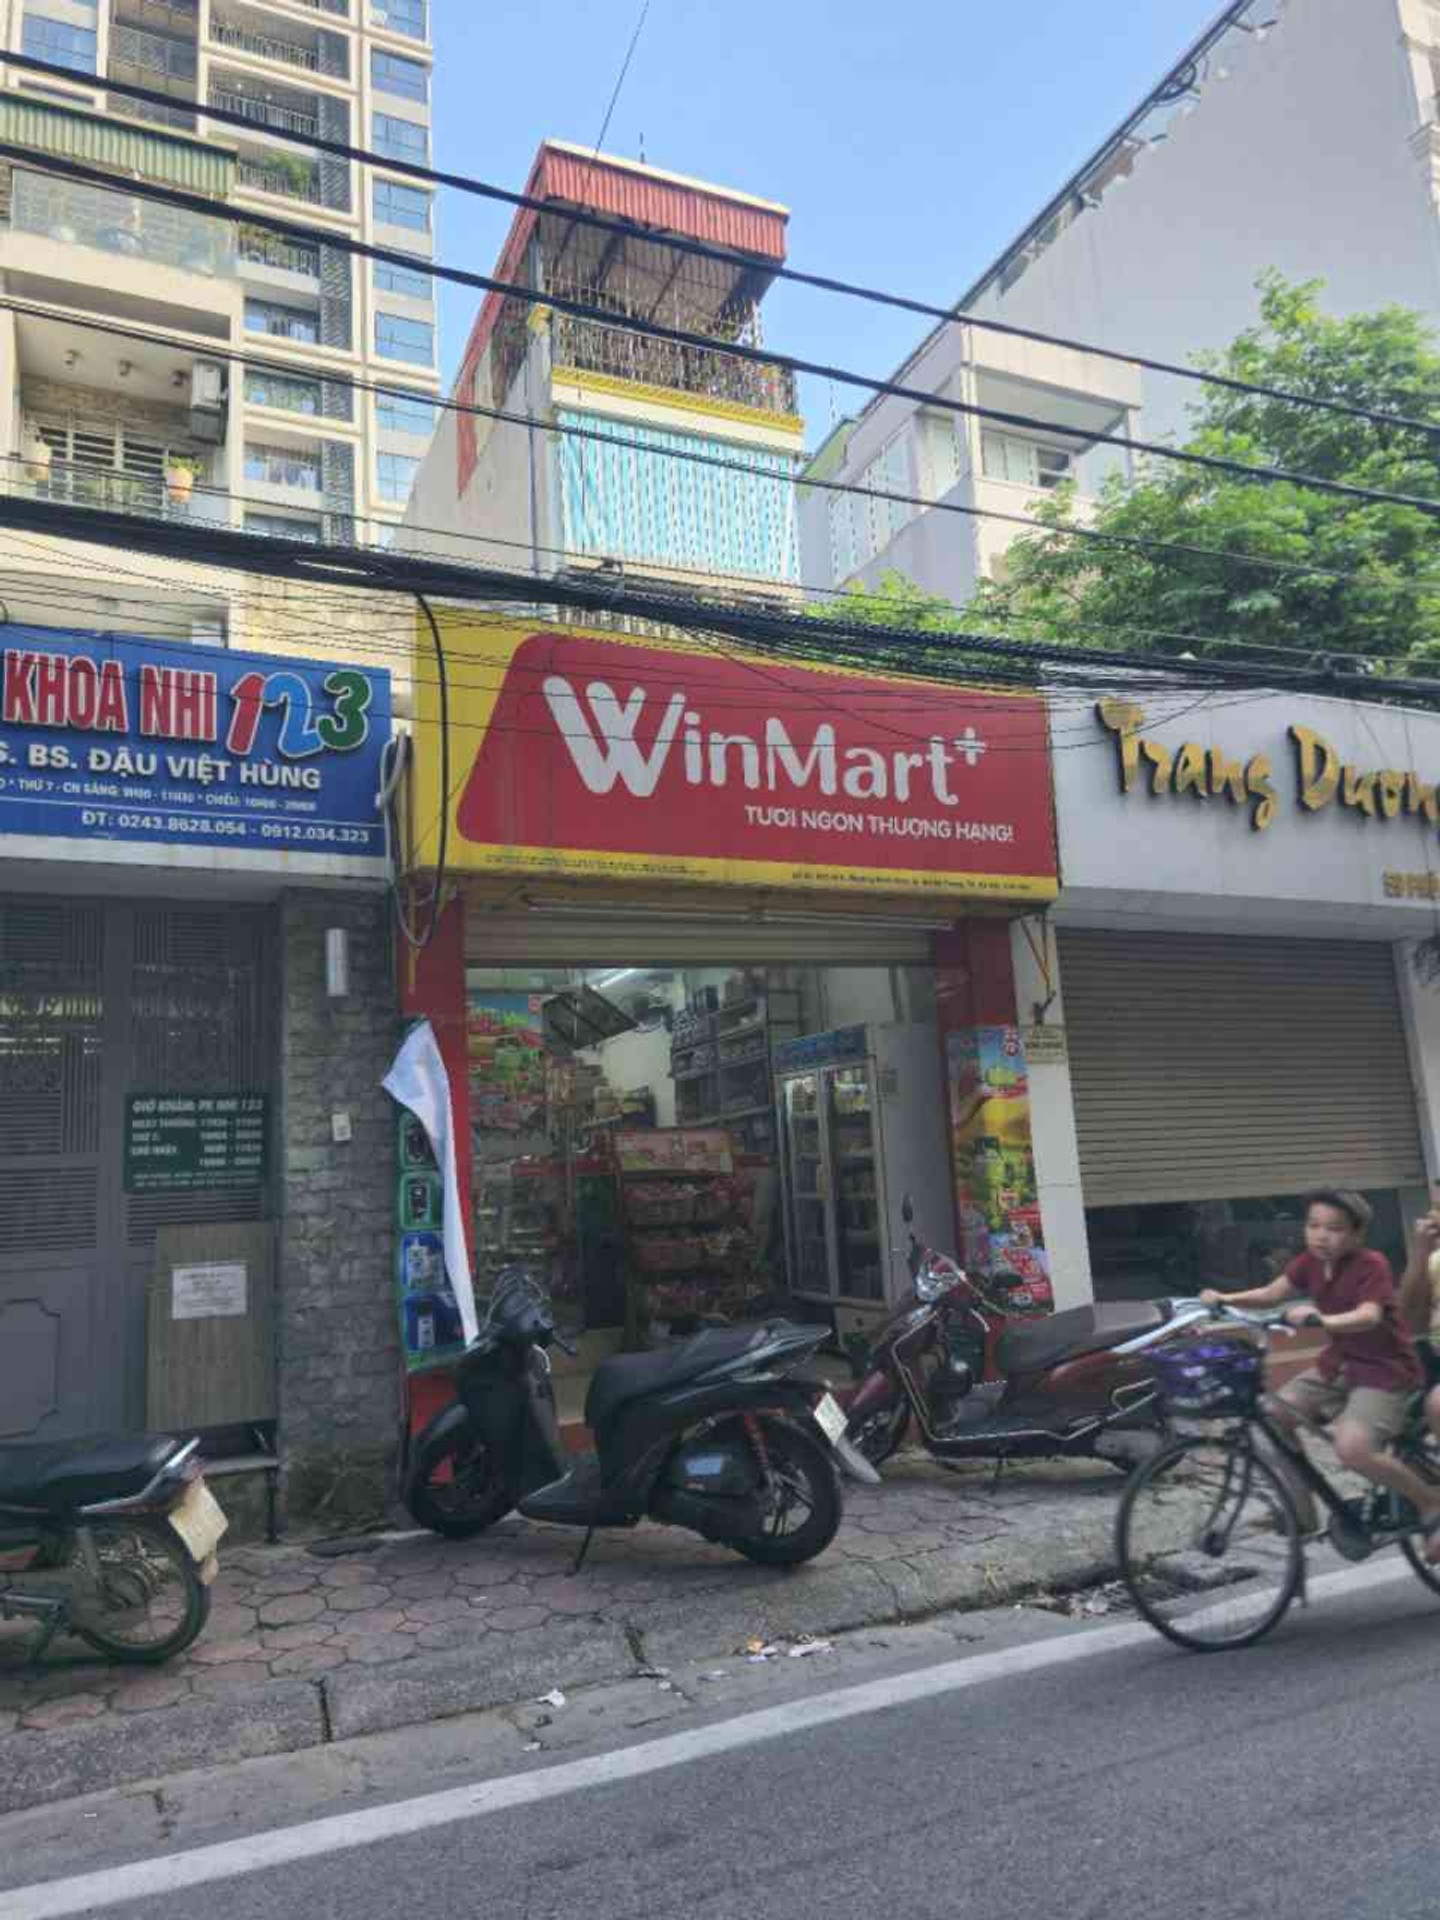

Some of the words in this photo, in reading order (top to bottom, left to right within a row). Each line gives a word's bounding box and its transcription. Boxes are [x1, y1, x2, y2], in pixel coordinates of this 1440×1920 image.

[3, 648, 129, 733] KHOA
[140, 664, 218, 742] NHI
[226, 670, 372, 757] 123
[28, 743, 78, 769] BS.
[88, 746, 157, 778] ĐẬU
[166, 753, 232, 786] VIỆT
[239, 758, 321, 790] HÙNG
[1094, 697, 1279, 832] Trang
[801, 809, 864, 832] NGON
